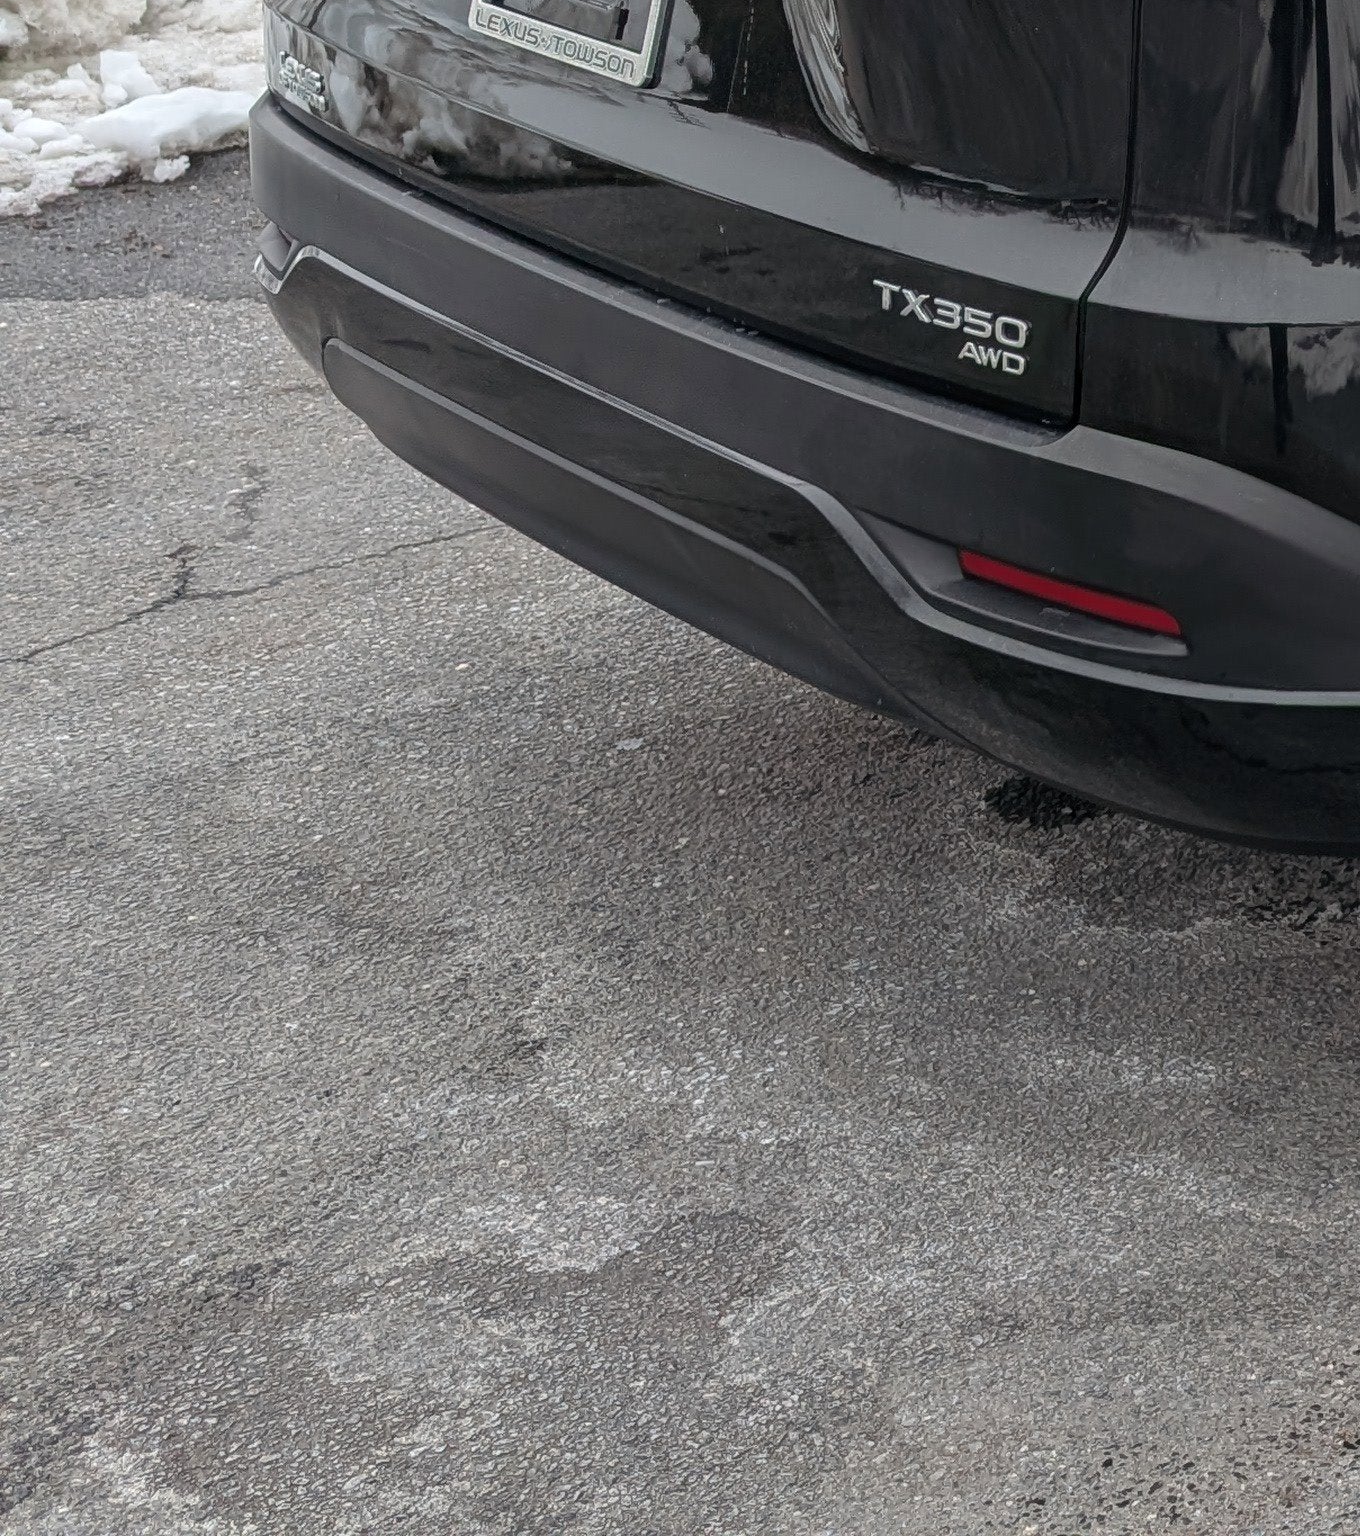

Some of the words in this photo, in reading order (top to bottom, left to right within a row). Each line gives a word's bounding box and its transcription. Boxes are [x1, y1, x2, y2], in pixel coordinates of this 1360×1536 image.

[476, 9, 539, 45] LEXUS
[873, 279, 1028, 348] TX350
[958, 341, 1025, 375] AWD
